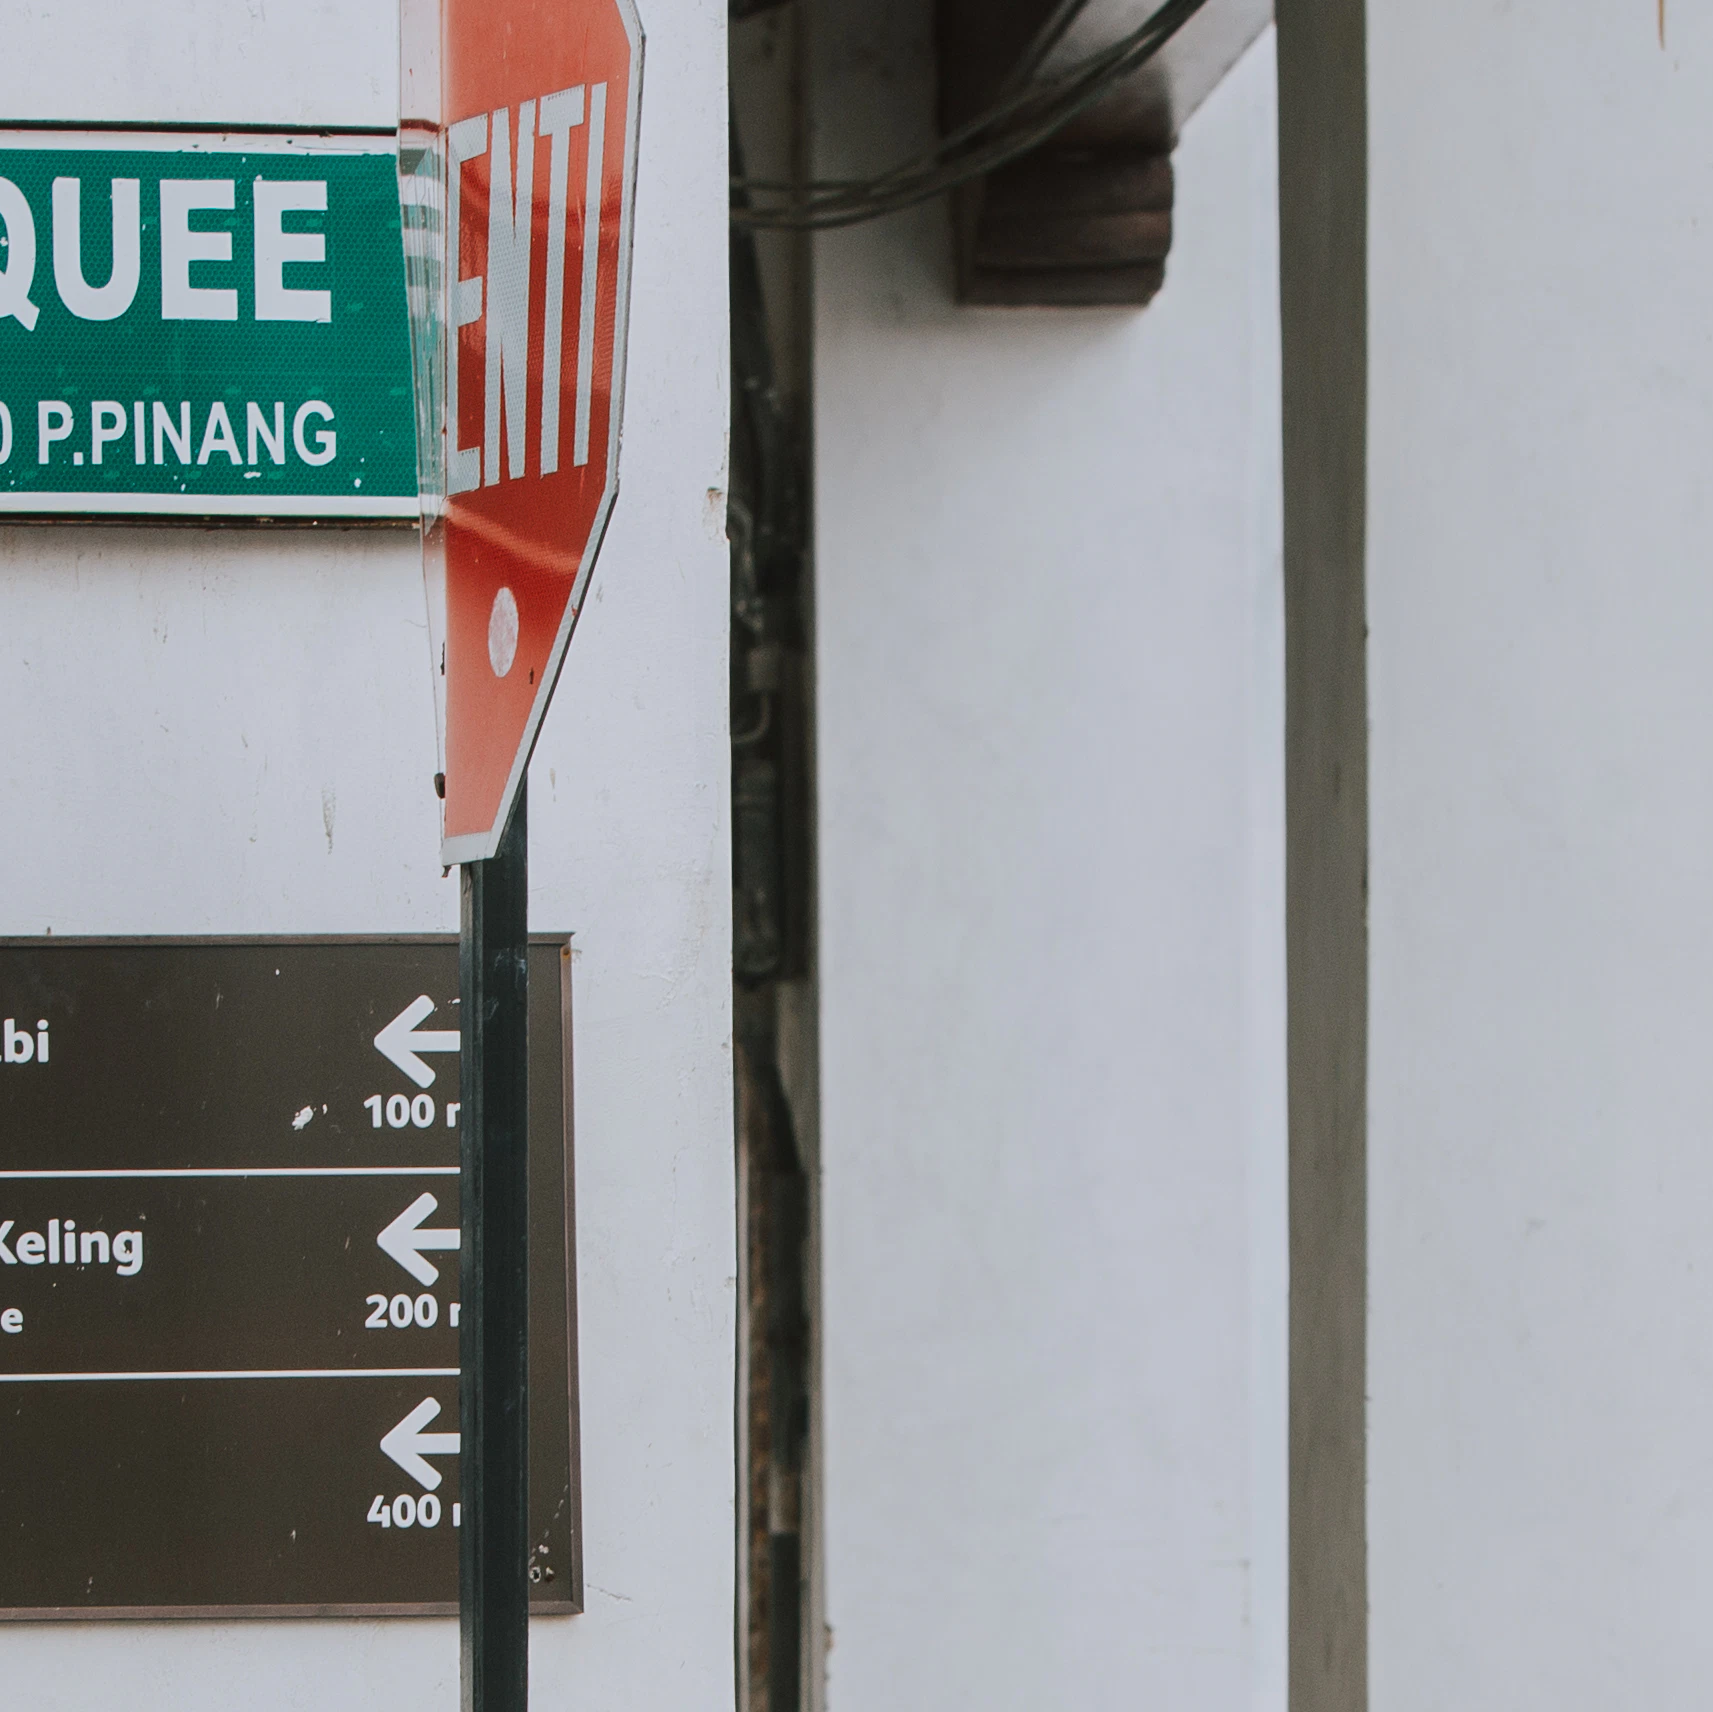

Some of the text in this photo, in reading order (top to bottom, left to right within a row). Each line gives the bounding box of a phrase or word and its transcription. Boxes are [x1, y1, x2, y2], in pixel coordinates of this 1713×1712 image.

[38, 400, 337, 466] P.PINANG
[363, 1093, 436, 1129] 100
[364, 1293, 439, 1329] 200
[366, 1493, 442, 1528] 400
